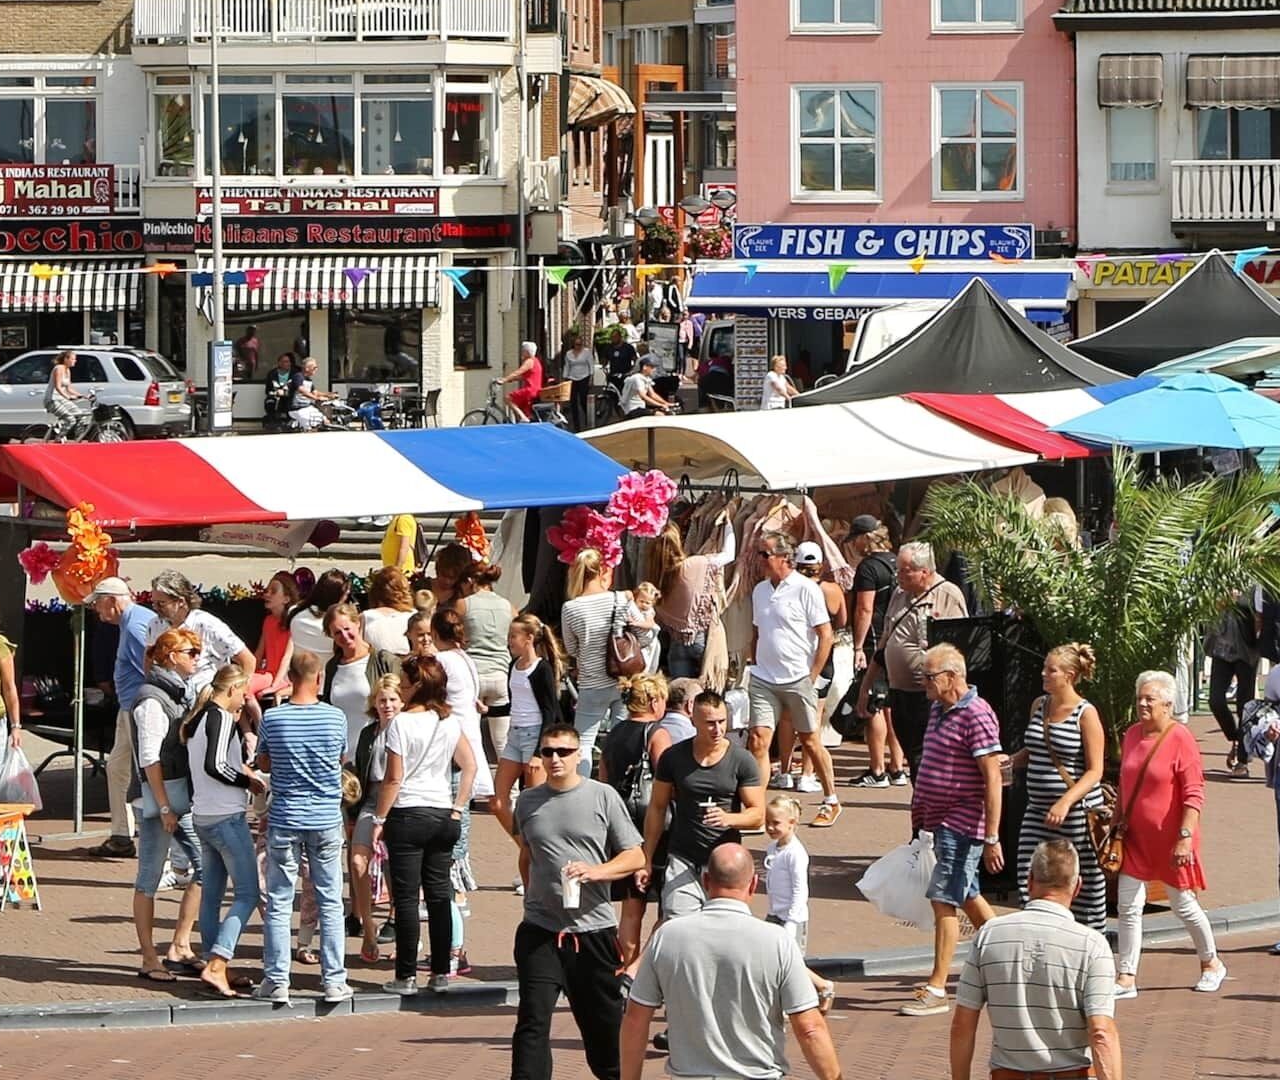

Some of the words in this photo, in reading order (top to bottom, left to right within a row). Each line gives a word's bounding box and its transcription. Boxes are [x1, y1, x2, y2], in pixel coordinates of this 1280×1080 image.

[6, 168, 45, 178] INDIAAS
[47, 167, 109, 178] RESTAURANT
[14, 180, 91, 199] Mahal
[287, 188, 343, 198] INDIAAS
[348, 187, 436, 198] RESTAURANT
[0, 206, 17, 215] 071
[28, 206, 47, 215] 362
[51, 206, 64, 215] 29
[67, 206, 80, 215] 90
[245, 199, 291, 213] Taj
[302, 199, 389, 211] Mahal
[194, 223, 298, 243] Itliaans
[307, 223, 442, 243] Restaurant
[779, 229, 845, 255] FISH
[855, 229, 884, 256] &
[894, 229, 986, 256] CHIPS
[768, 308, 807, 319] VERS
